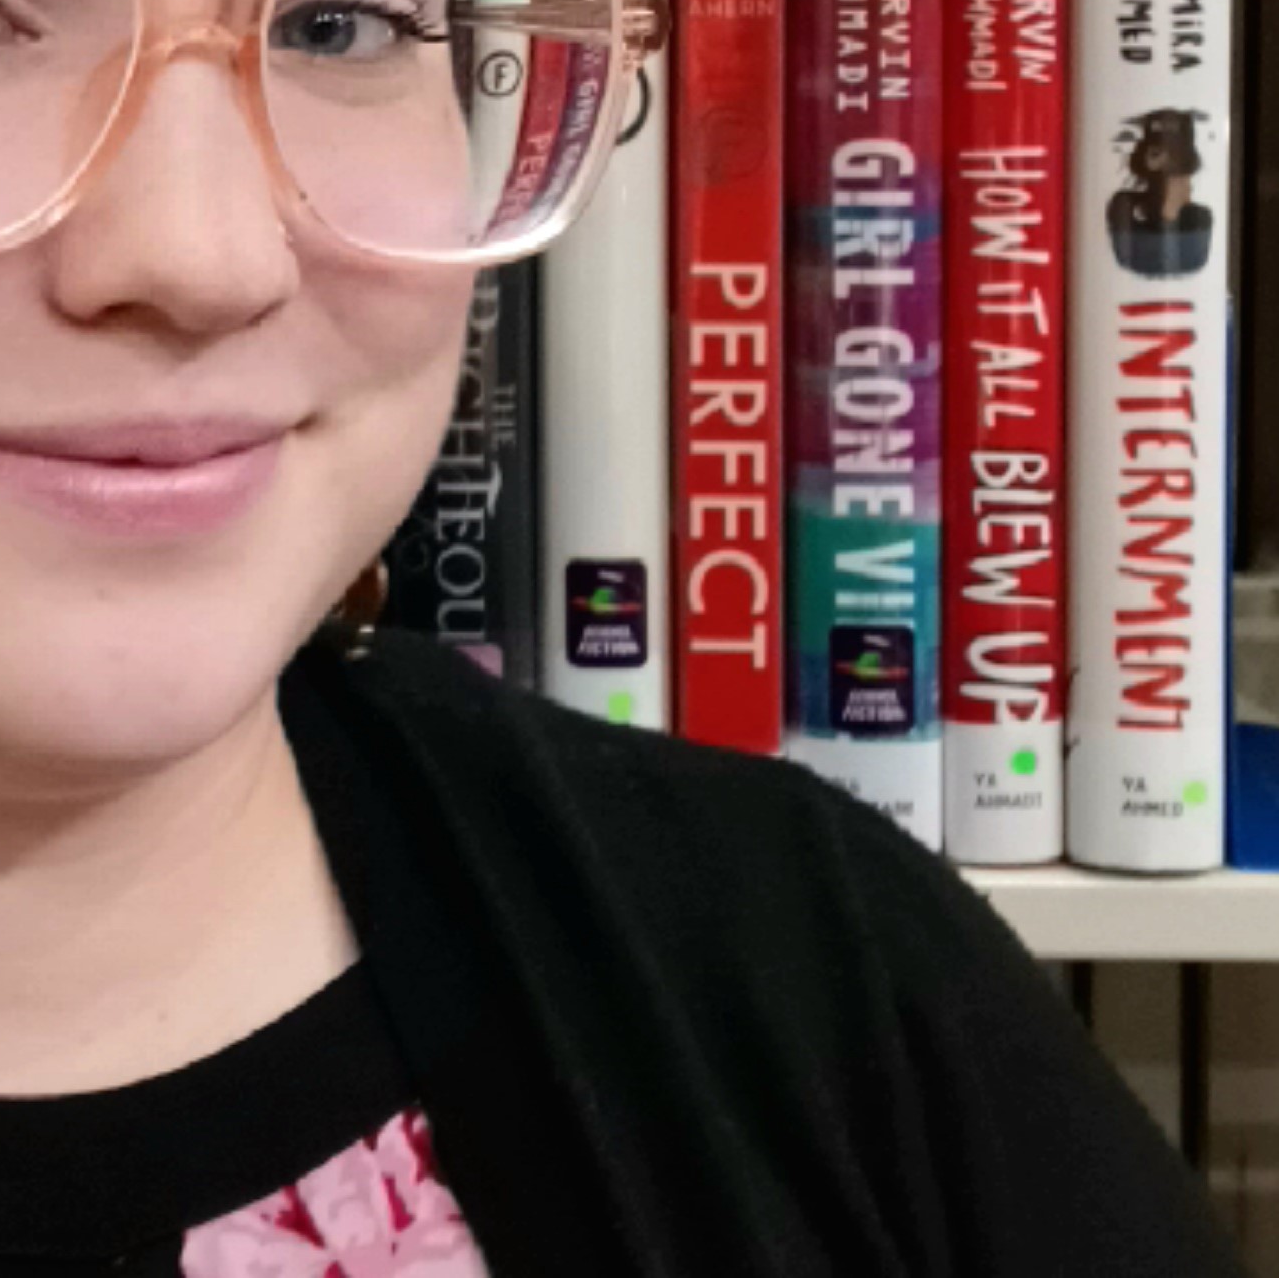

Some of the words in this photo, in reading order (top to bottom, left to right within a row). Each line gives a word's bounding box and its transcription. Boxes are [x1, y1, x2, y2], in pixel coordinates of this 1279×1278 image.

[832, 137, 916, 299] GIRL
[959, 144, 1051, 265] HOW
[489, 383, 518, 450] THE
[832, 327, 916, 517] GONE
[970, 339, 1044, 429] ALL
[687, 261, 770, 670] PERFECT
[1115, 299, 1199, 733] INTERNMENT
[961, 450, 1056, 610] BLEW
[958, 632, 1055, 725] UP
[975, 773, 996, 788] YA
[1122, 799, 1184, 818] AHMED
[1123, 777, 1146, 794] YA
